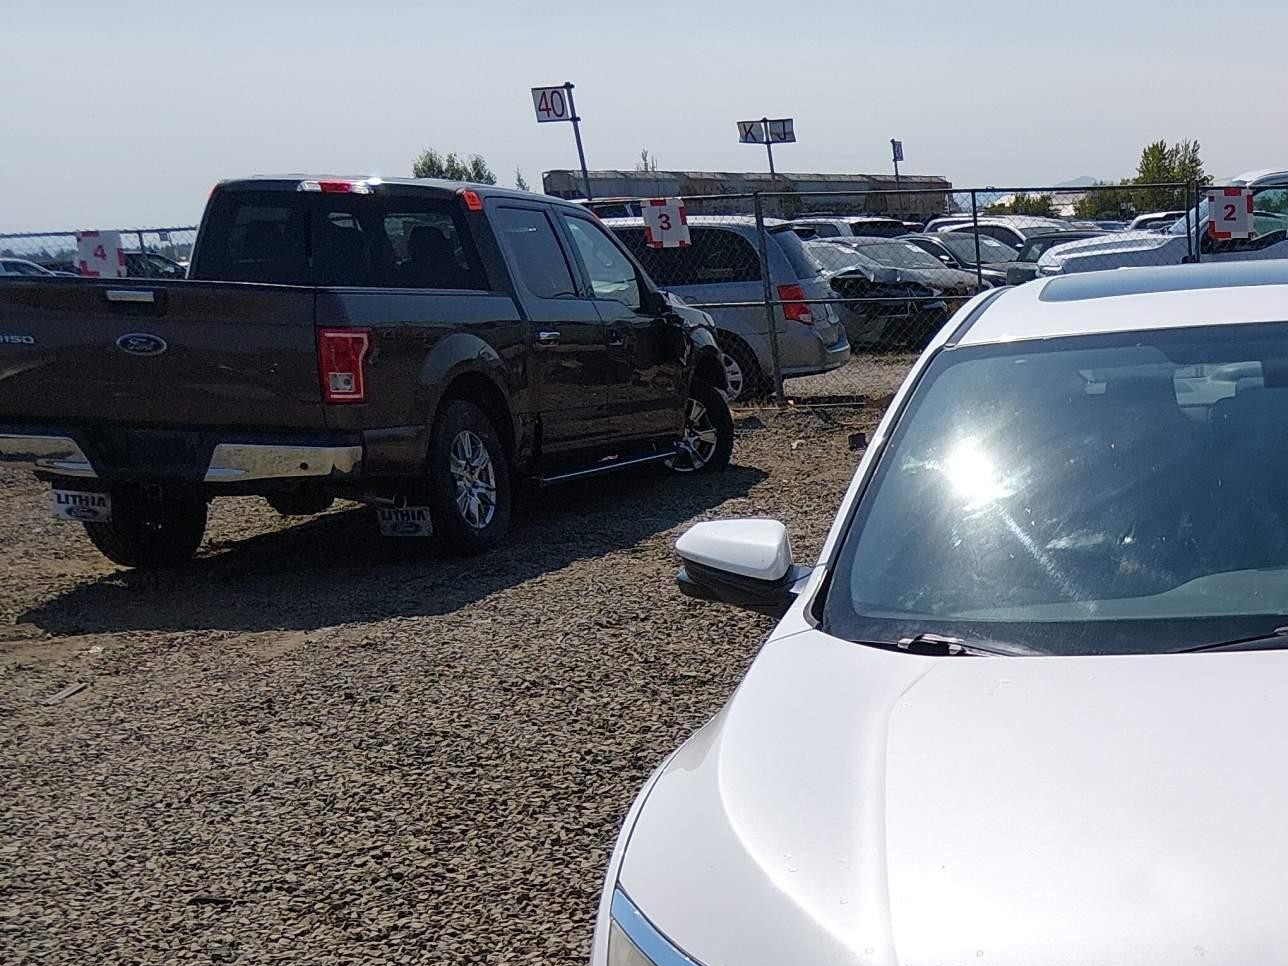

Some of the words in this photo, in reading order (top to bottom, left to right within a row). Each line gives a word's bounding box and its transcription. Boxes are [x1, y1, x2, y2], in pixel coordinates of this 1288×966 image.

[538, 90, 565, 118] 40
[743, 123, 757, 141] K
[777, 121, 787, 140] J
[1223, 203, 1237, 221] 2
[658, 213, 672, 230] 3
[94, 244, 107, 260] 4
[0, 335, 34, 344] 150
[56, 493, 108, 508] LITHIA
